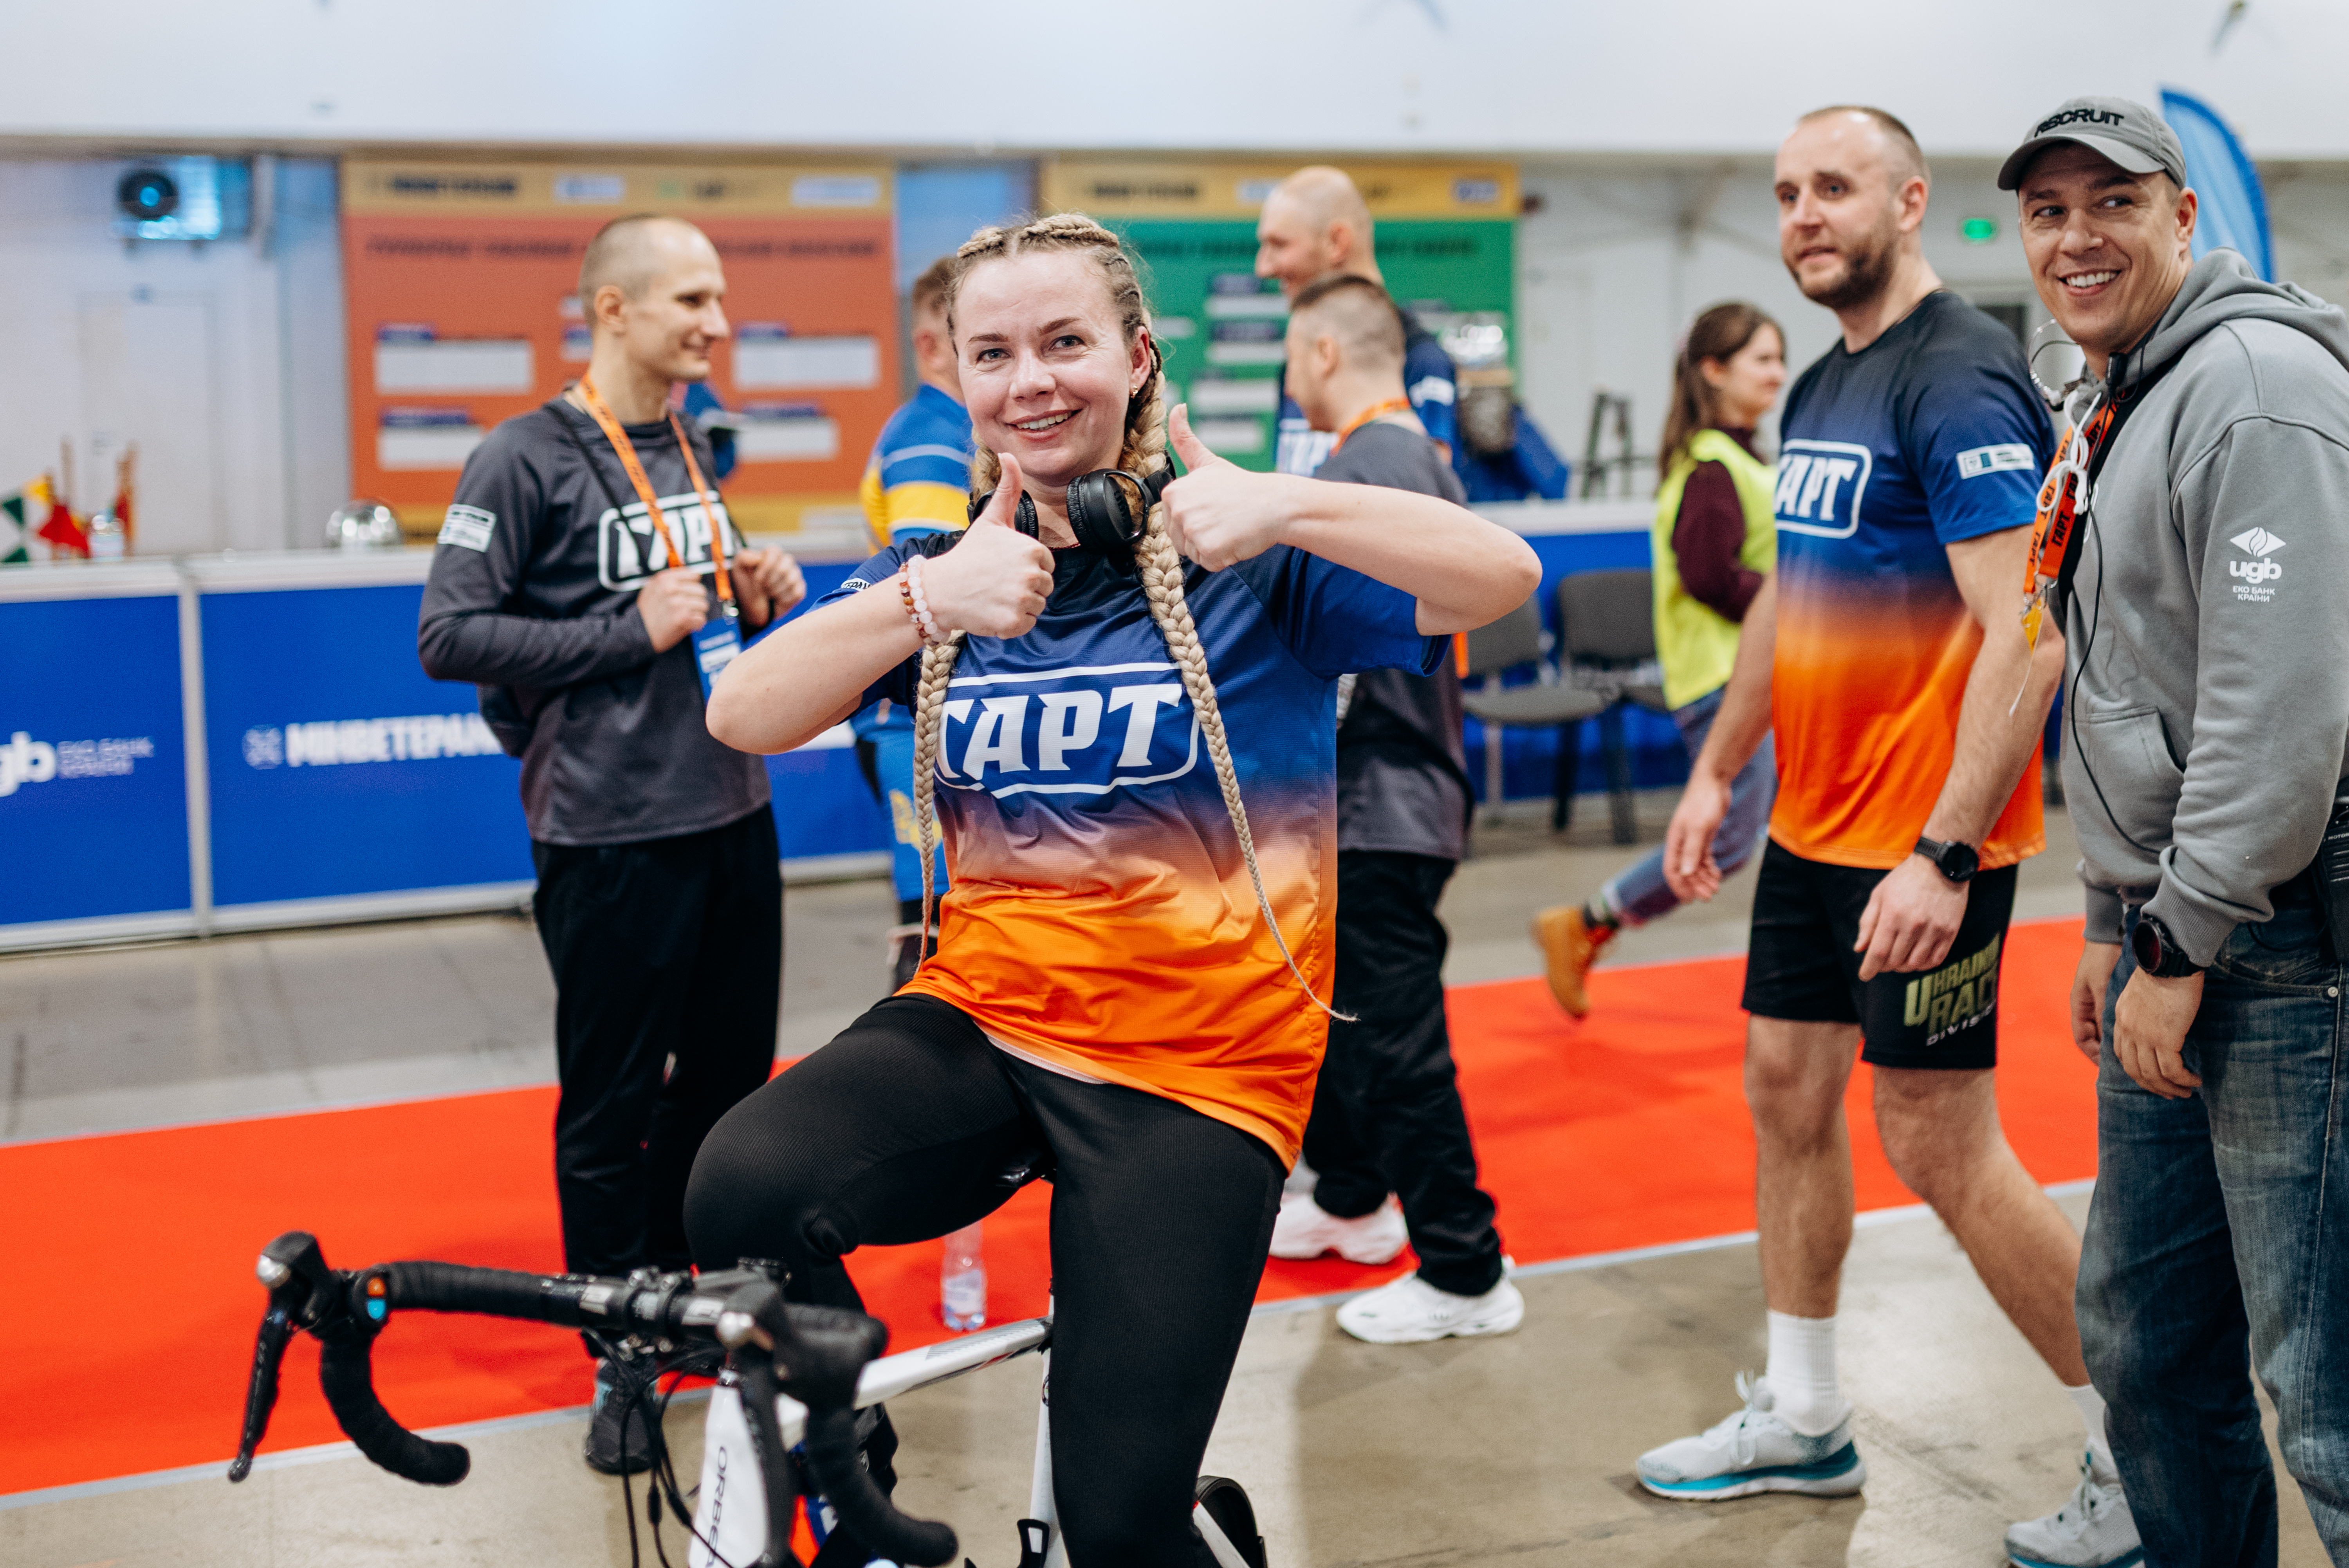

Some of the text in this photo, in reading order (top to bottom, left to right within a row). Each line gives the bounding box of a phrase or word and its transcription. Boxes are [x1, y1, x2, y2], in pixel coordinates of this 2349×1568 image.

[2086, 420, 2102, 447] АРТ
[2051, 511, 2070, 547] ГАРТ
[2230, 558, 2282, 584] ugb
[2238, 593, 2270, 602] КРАЇНИ
[2252, 586, 2275, 595] БАНК
[937, 684, 1182, 780] ГАРТ
